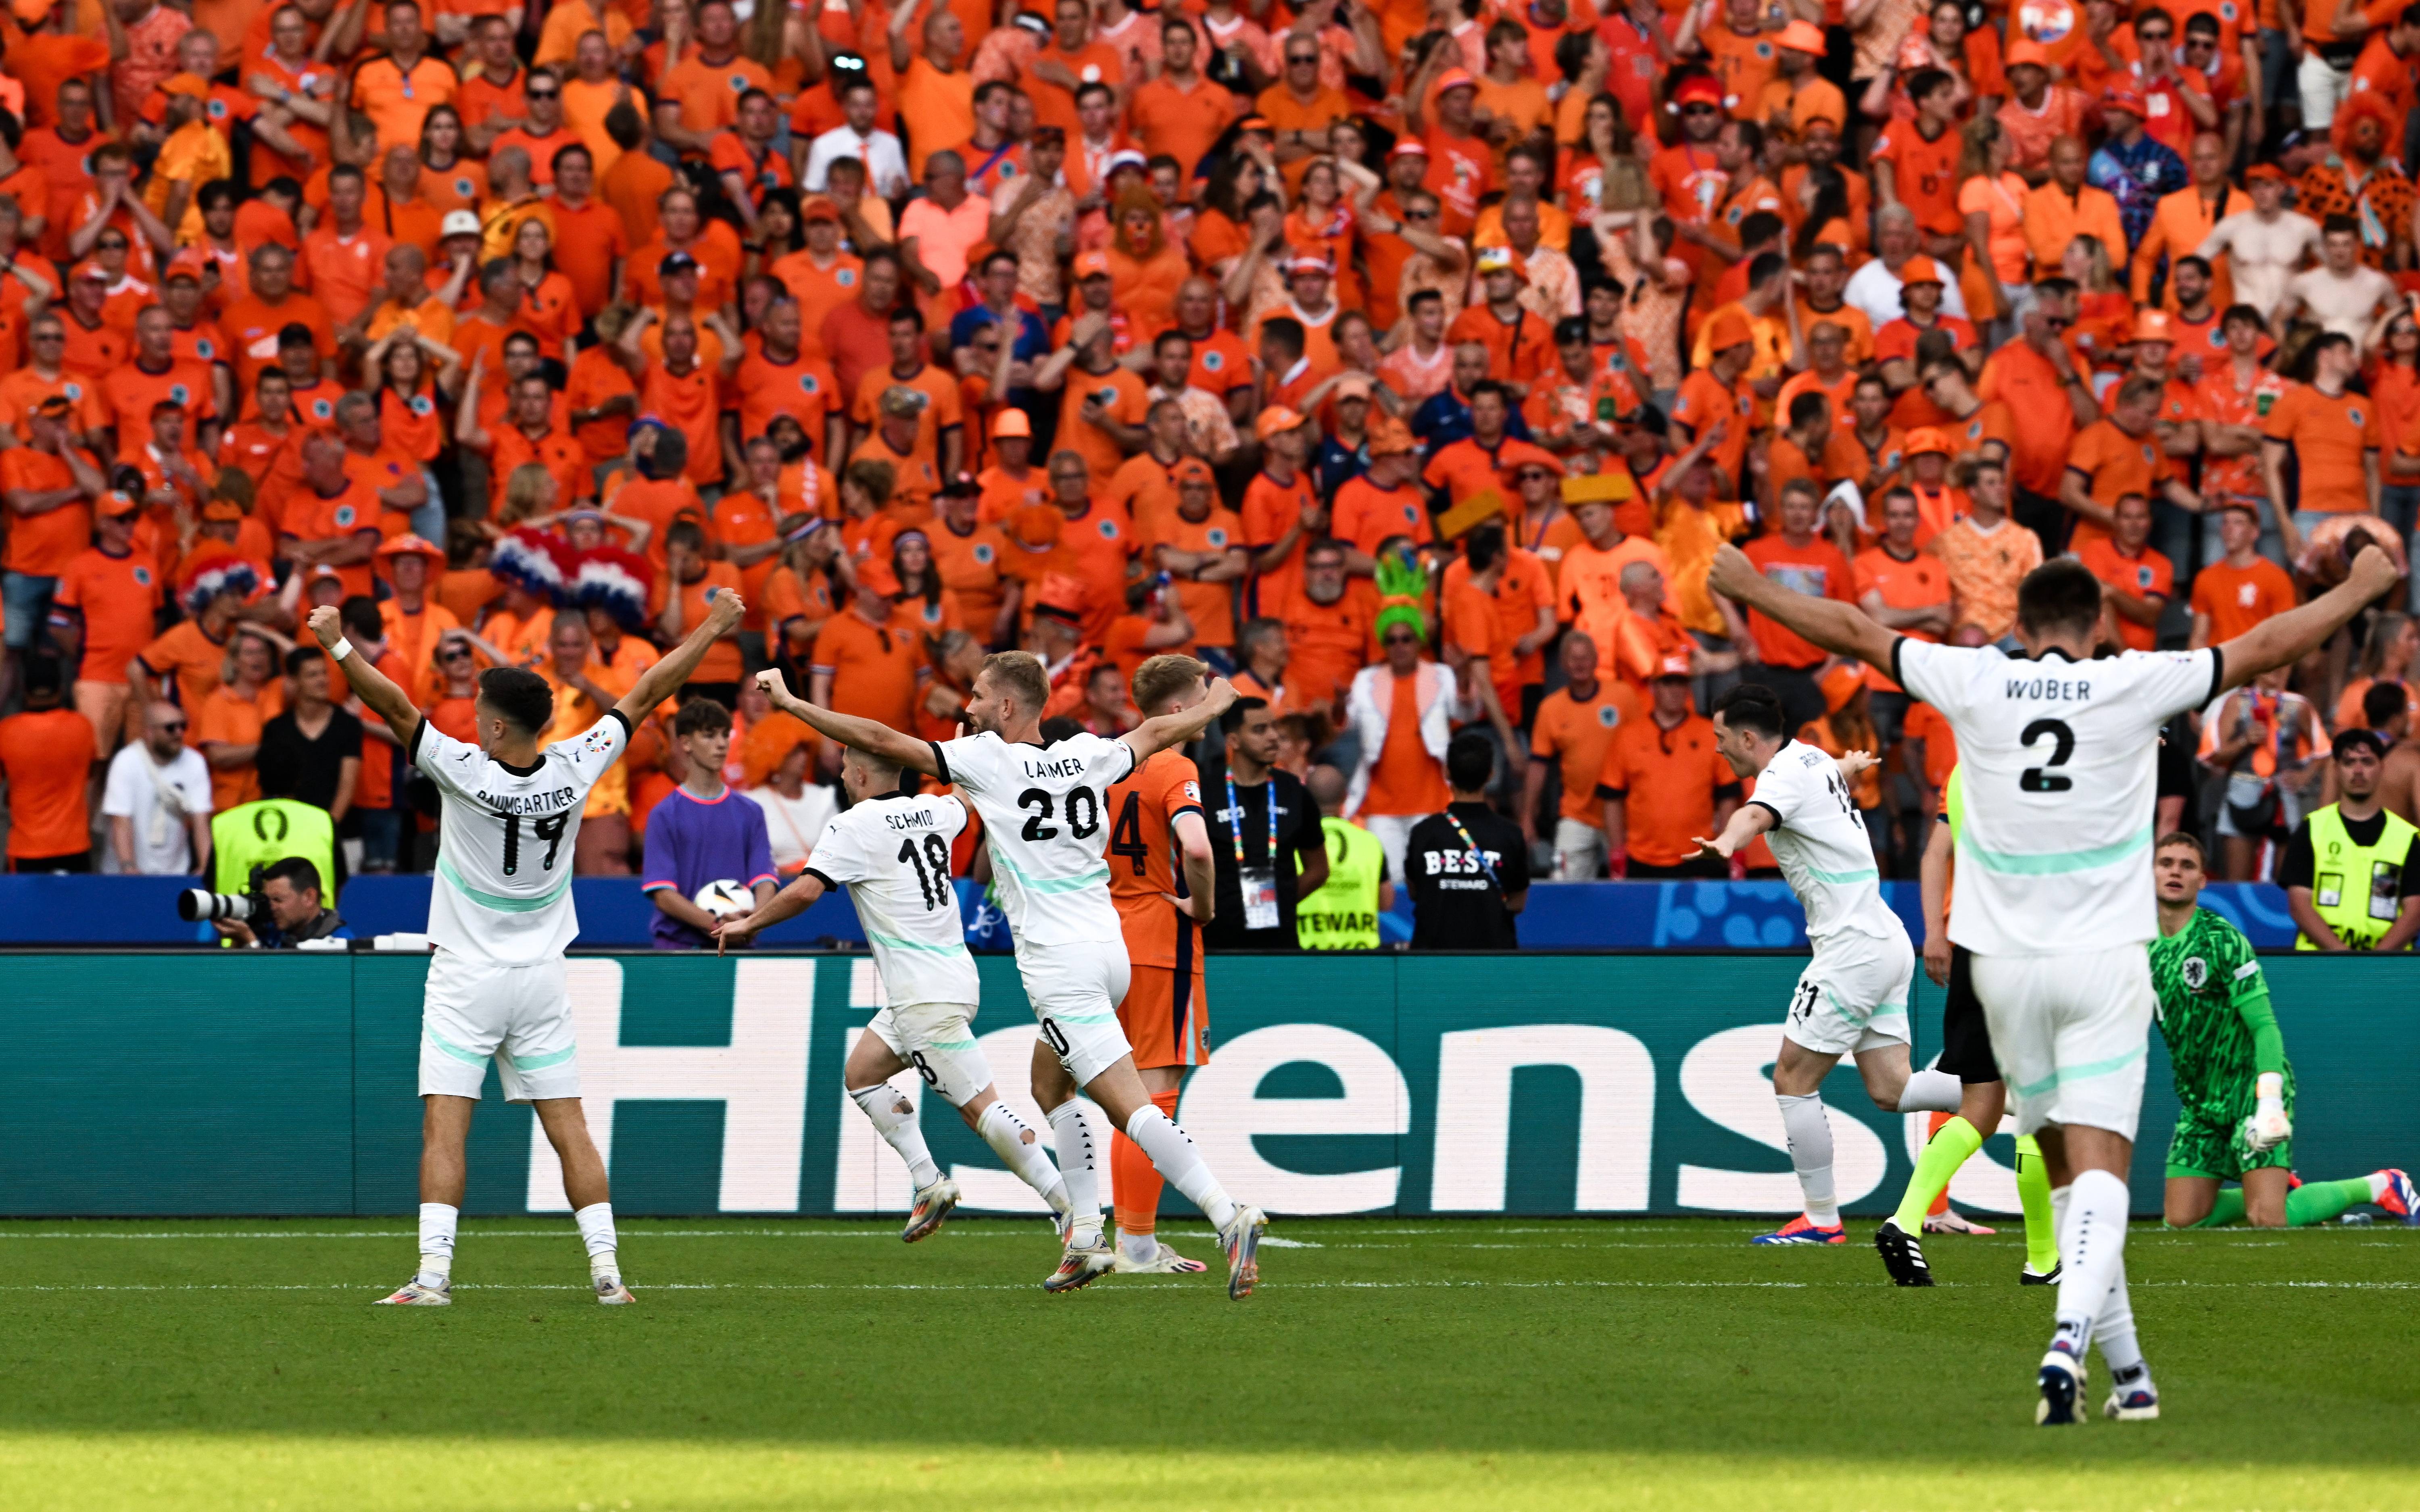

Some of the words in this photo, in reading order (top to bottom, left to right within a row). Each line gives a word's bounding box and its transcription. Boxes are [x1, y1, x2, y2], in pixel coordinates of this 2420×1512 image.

[1024, 758, 1085, 778] LAIMER
[2020, 718, 2075, 792] 2
[477, 786, 577, 814] BAUMGARTNER
[885, 810, 933, 829] SCHMID
[1018, 785, 1099, 842] 20
[489, 809, 570, 876] 19
[1104, 788, 1148, 876] 4
[897, 833, 951, 912] 18
[1795, 980, 1819, 1017] 11
